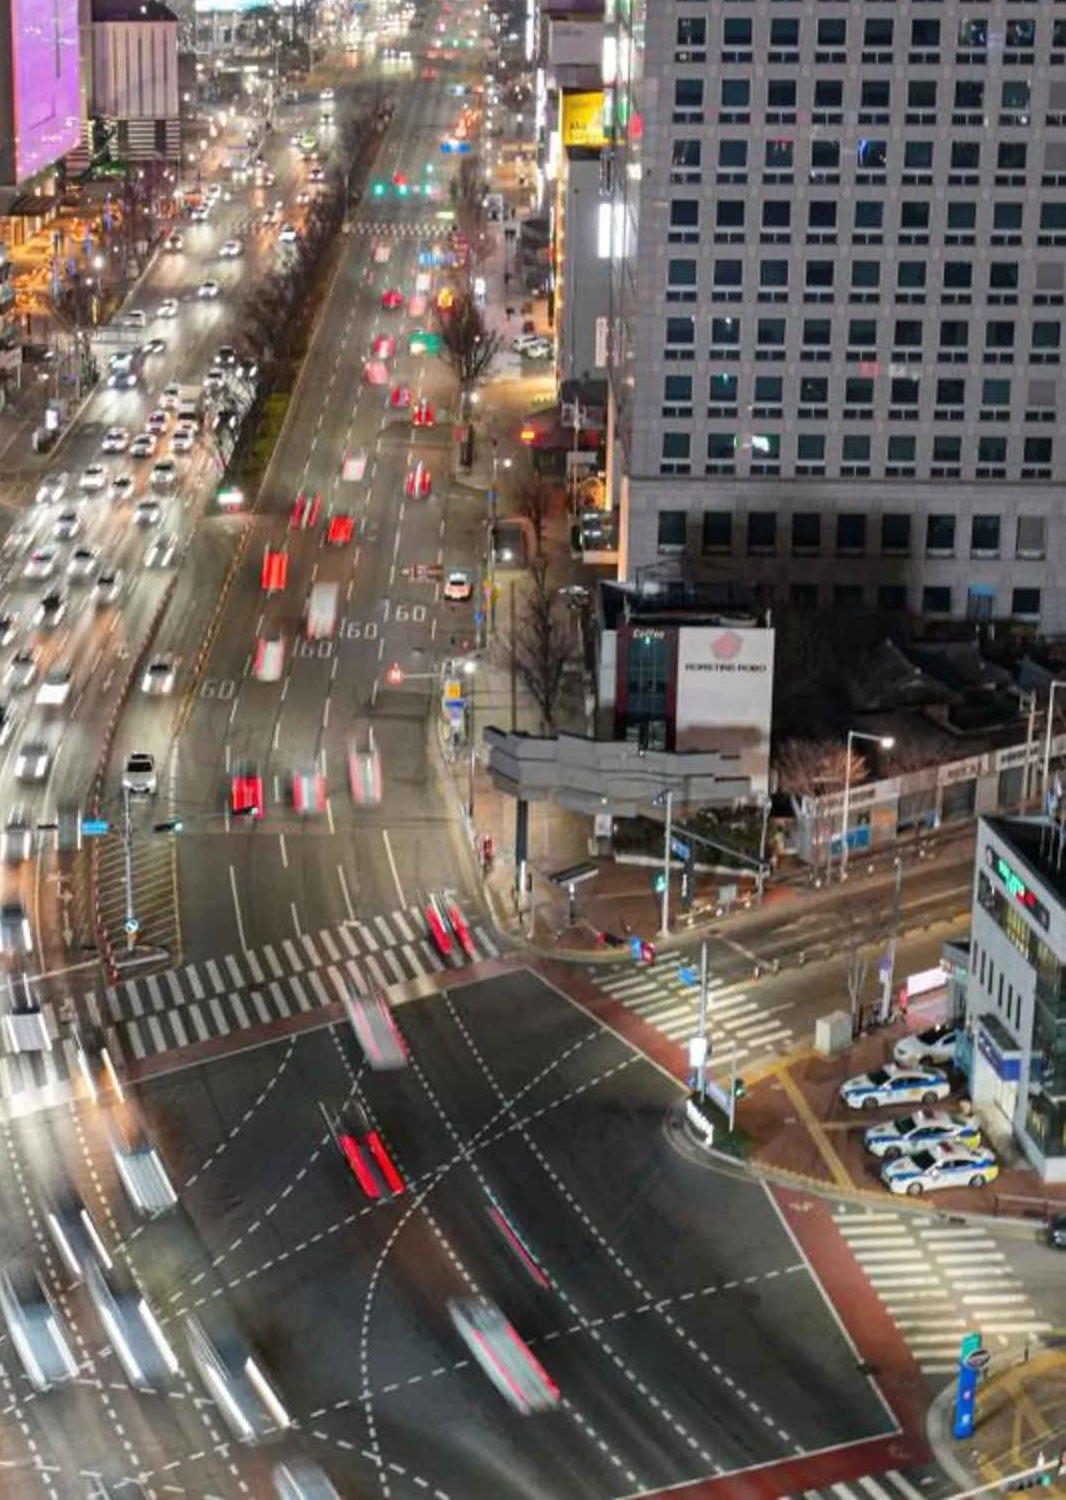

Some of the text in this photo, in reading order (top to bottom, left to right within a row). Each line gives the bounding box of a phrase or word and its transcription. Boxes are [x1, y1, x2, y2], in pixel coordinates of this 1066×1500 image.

[395, 604, 427, 623] 60
[347, 622, 378, 640] 60
[300, 640, 334, 659] 60
[199, 680, 234, 699] 60
